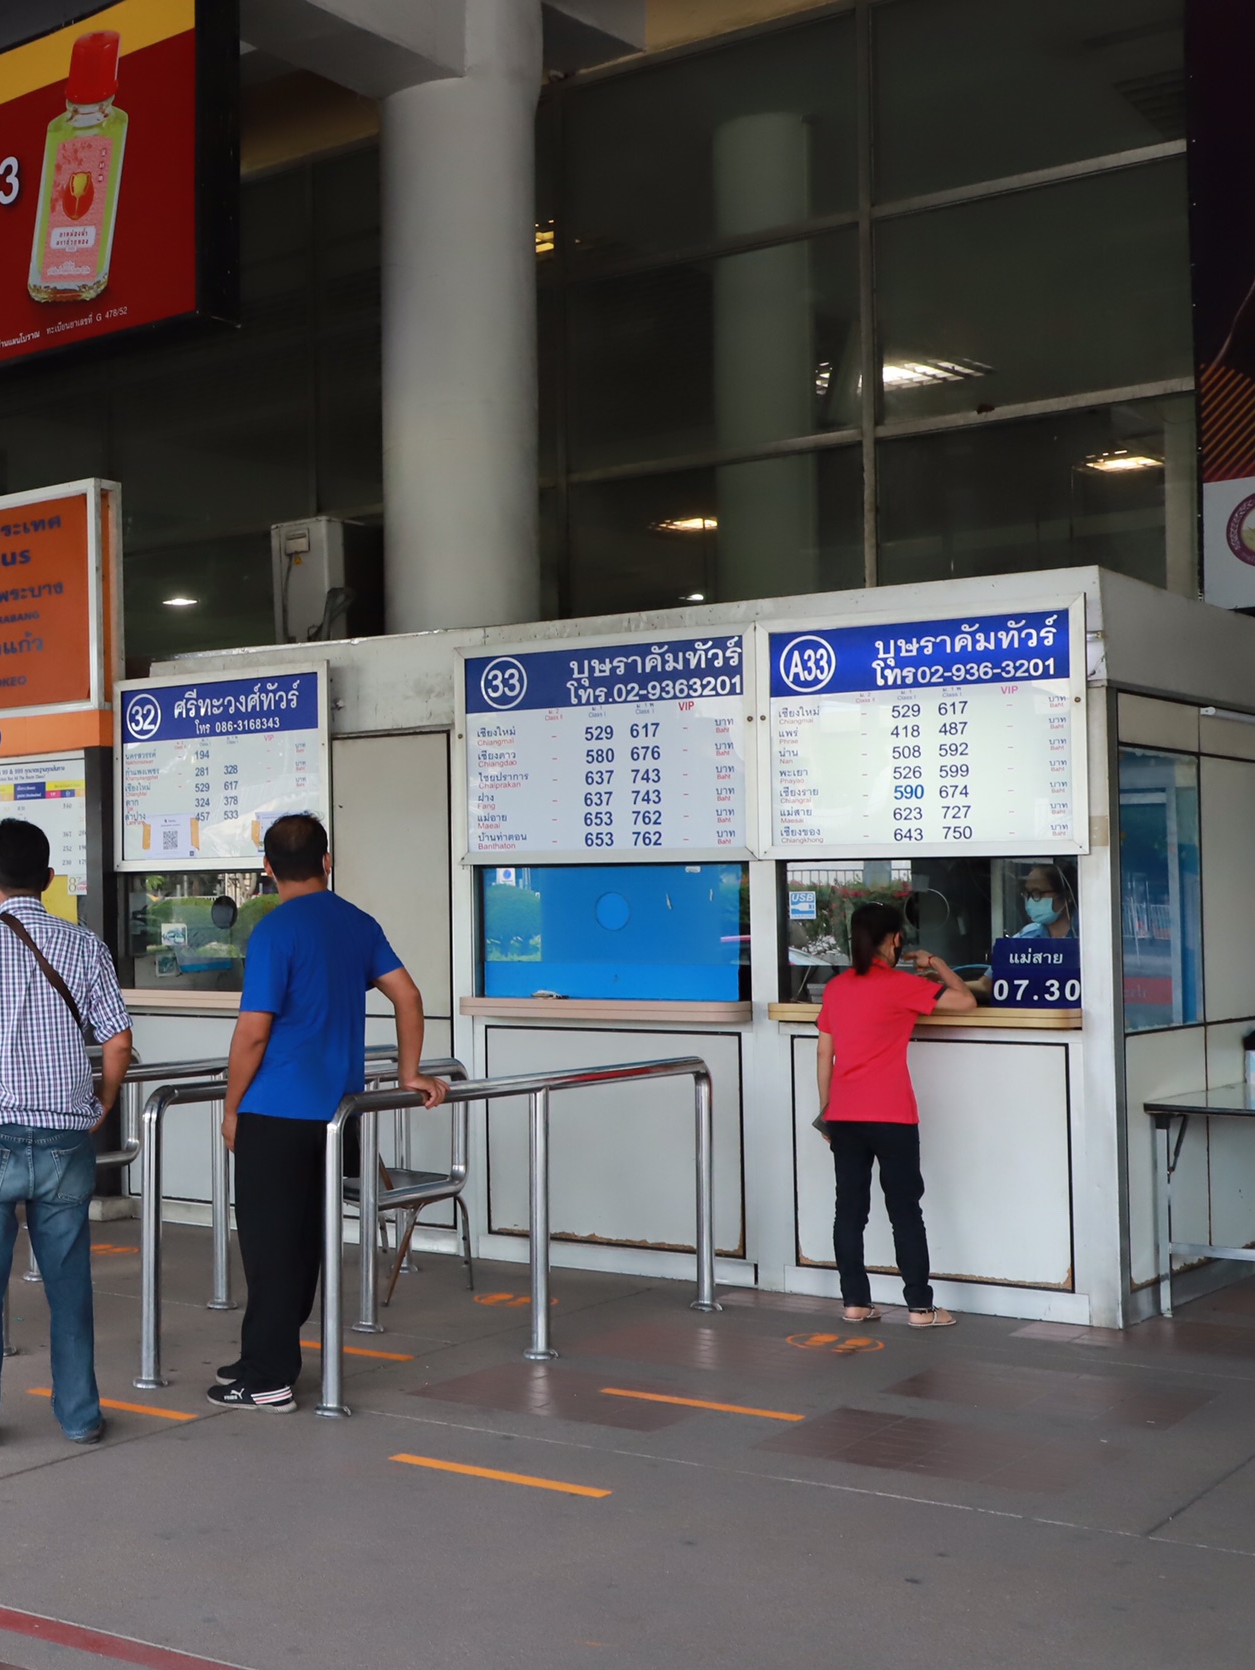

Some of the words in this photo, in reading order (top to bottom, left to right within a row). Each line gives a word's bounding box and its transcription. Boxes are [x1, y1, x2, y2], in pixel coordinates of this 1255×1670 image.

[96, 313, 102, 322] G
[105, 306, 127, 319] 478/52
[875, 614, 1058, 668] บุษราคัมทัวร์
[569, 636, 743, 686] บุษราคัมทัวร์
[788, 648, 830, 682] A33
[487, 668, 521, 698] 33
[566, 675, 743, 704] โทร.02-9363201
[1000, 685, 1019, 695] VIP
[174, 680, 300, 719] ศรีทะวงศ์ทัวร์
[678, 701, 695, 712] VIP
[131, 704, 155, 731] 32
[778, 706, 820, 718] เชียงใหม่
[891, 703, 921, 719] 529
[938, 701, 968, 716] 617
[195, 720, 211, 735] โทร
[215, 717, 280, 733] 086-3168343
[477, 727, 516, 738] เชียงใหม่
[584, 725, 614, 741] 529
[629, 722, 661, 738] 617
[715, 718, 734, 726] บาท
[779, 726, 798, 738] แพร่
[890, 724, 921, 739] 418
[938, 721, 968, 736] 487
[264, 734, 274, 742] VIP
[195, 750, 210, 760] 194
[477, 750, 517, 760] เชียงดาว
[585, 748, 615, 764] 580
[630, 746, 661, 761] 676
[715, 741, 734, 750] บาท
[779, 748, 799, 758] น่าน
[892, 745, 922, 759] 508
[938, 742, 969, 757] 592
[195, 767, 209, 777] 281
[224, 765, 238, 775] 328
[479, 772, 529, 782] ไชยปราการ
[585, 770, 615, 785] 637
[631, 768, 661, 784] 743
[715, 764, 735, 773] บาท
[779, 768, 808, 778] พะเยา
[893, 765, 922, 780] 526
[939, 763, 970, 778] 599
[195, 783, 210, 792] 529
[224, 781, 238, 790] 617
[780, 787, 819, 797] เชียงราย
[893, 784, 924, 800] 590
[939, 784, 969, 799] 674
[195, 798, 210, 808] 324
[224, 796, 238, 806] 378
[477, 792, 495, 802] ฝาง
[584, 791, 613, 807] 637
[631, 790, 662, 805] 743
[715, 786, 735, 796] บาท
[195, 812, 210, 821] 457
[224, 810, 239, 819] 533
[477, 812, 507, 823] แม่อาย
[583, 811, 613, 826] 653
[631, 810, 662, 826] 762
[715, 808, 735, 817] บาท
[780, 806, 812, 817] แม่สาย
[893, 806, 923, 821] 623
[941, 805, 971, 820] 727
[478, 831, 527, 842] บ้านท่าตอน
[584, 832, 614, 847] 653
[632, 831, 663, 846] 762
[717, 829, 736, 838] บาท
[780, 826, 821, 837] เชียงของ
[893, 827, 924, 842] 643
[942, 826, 973, 840] 750
[1009, 948, 1063, 965] แม่สาย
[994, 979, 1081, 1002] 07.30
